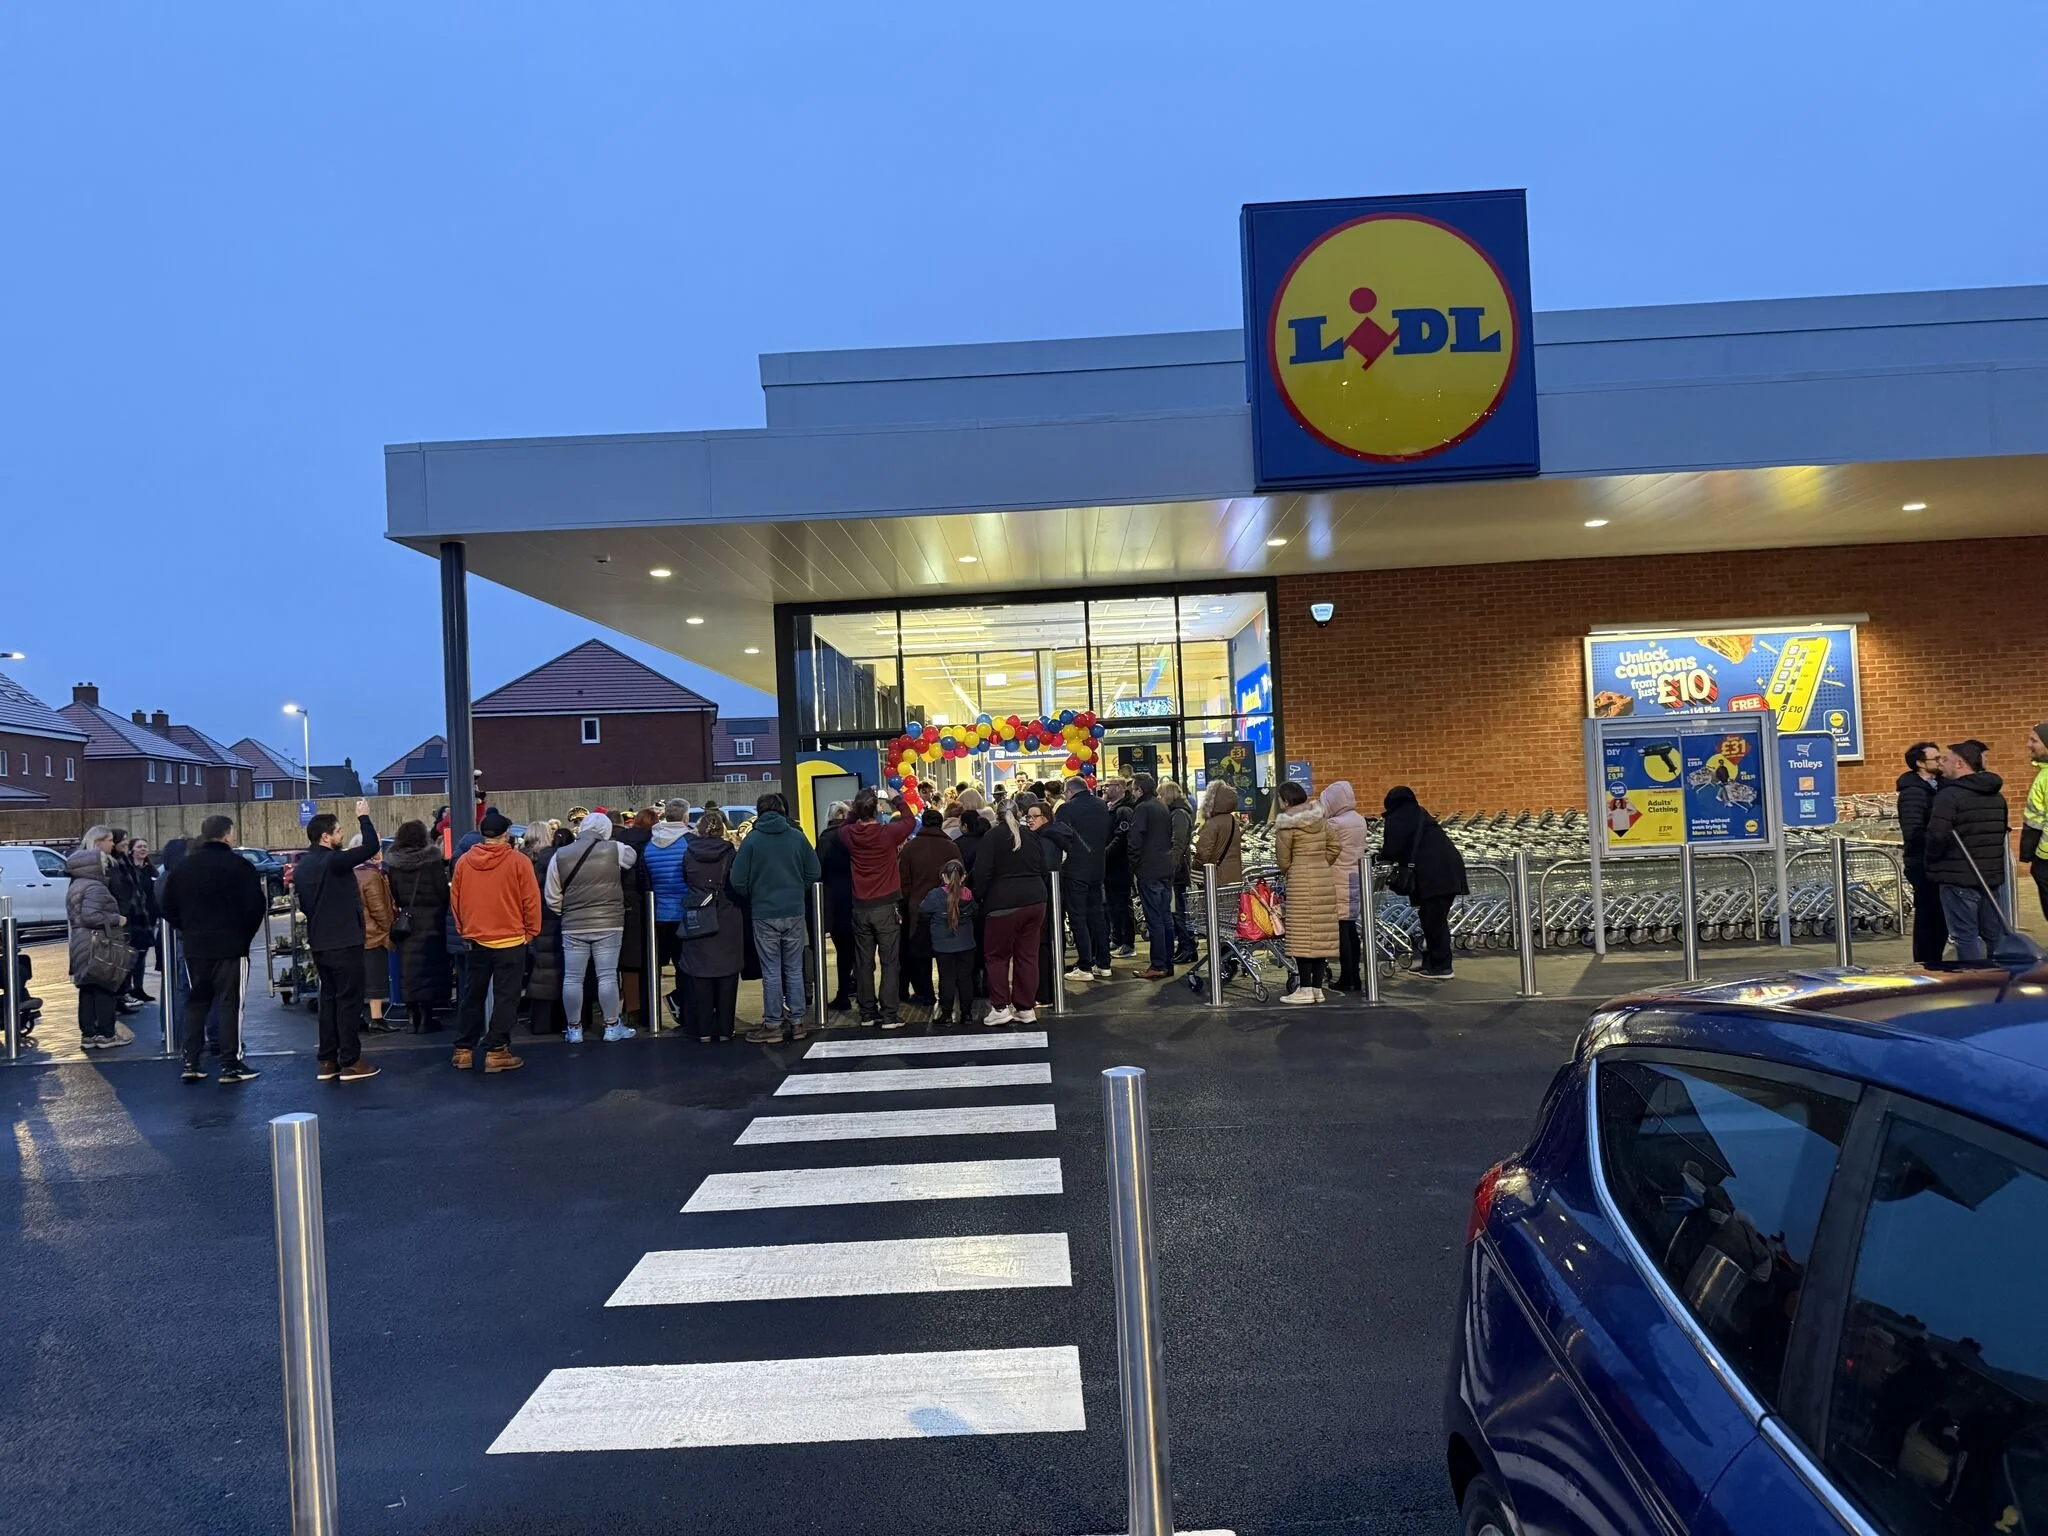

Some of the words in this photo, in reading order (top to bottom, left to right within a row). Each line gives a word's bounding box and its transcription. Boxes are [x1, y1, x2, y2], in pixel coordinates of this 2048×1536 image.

[1619, 647, 1668, 664] Unlock
[1615, 656, 1697, 678] coupons
[1631, 679, 1656, 689] from
[1657, 668, 1713, 704] £10
[1638, 688, 1656, 699] just
[1731, 698, 1761, 711] FREE
[1788, 705, 1803, 714] £10
[1720, 738, 1746, 755] £31
[1788, 760, 1823, 769] Trolleys
[1648, 806, 1679, 814] Clothing
